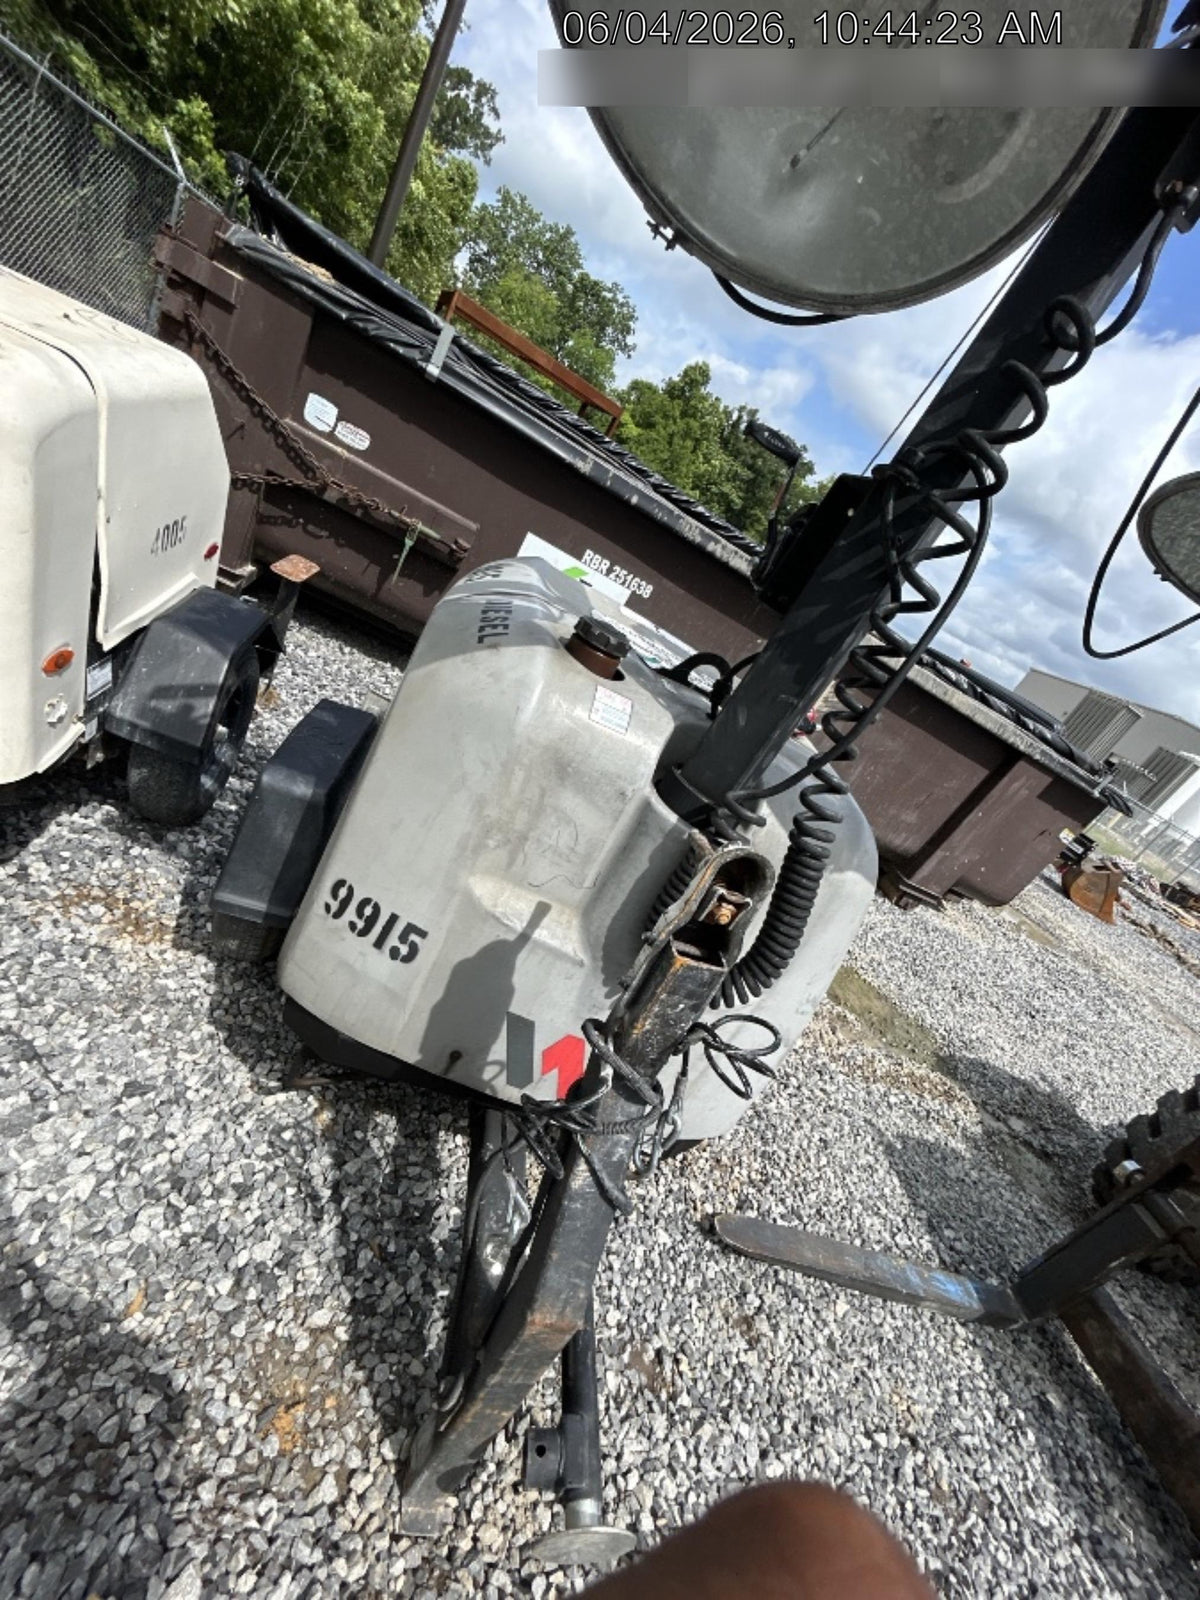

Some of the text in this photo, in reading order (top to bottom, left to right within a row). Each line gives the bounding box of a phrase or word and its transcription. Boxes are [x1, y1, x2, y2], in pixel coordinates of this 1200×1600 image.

[581, 549, 653, 598] RBR 251638
[324, 878, 429, 964] 9915
